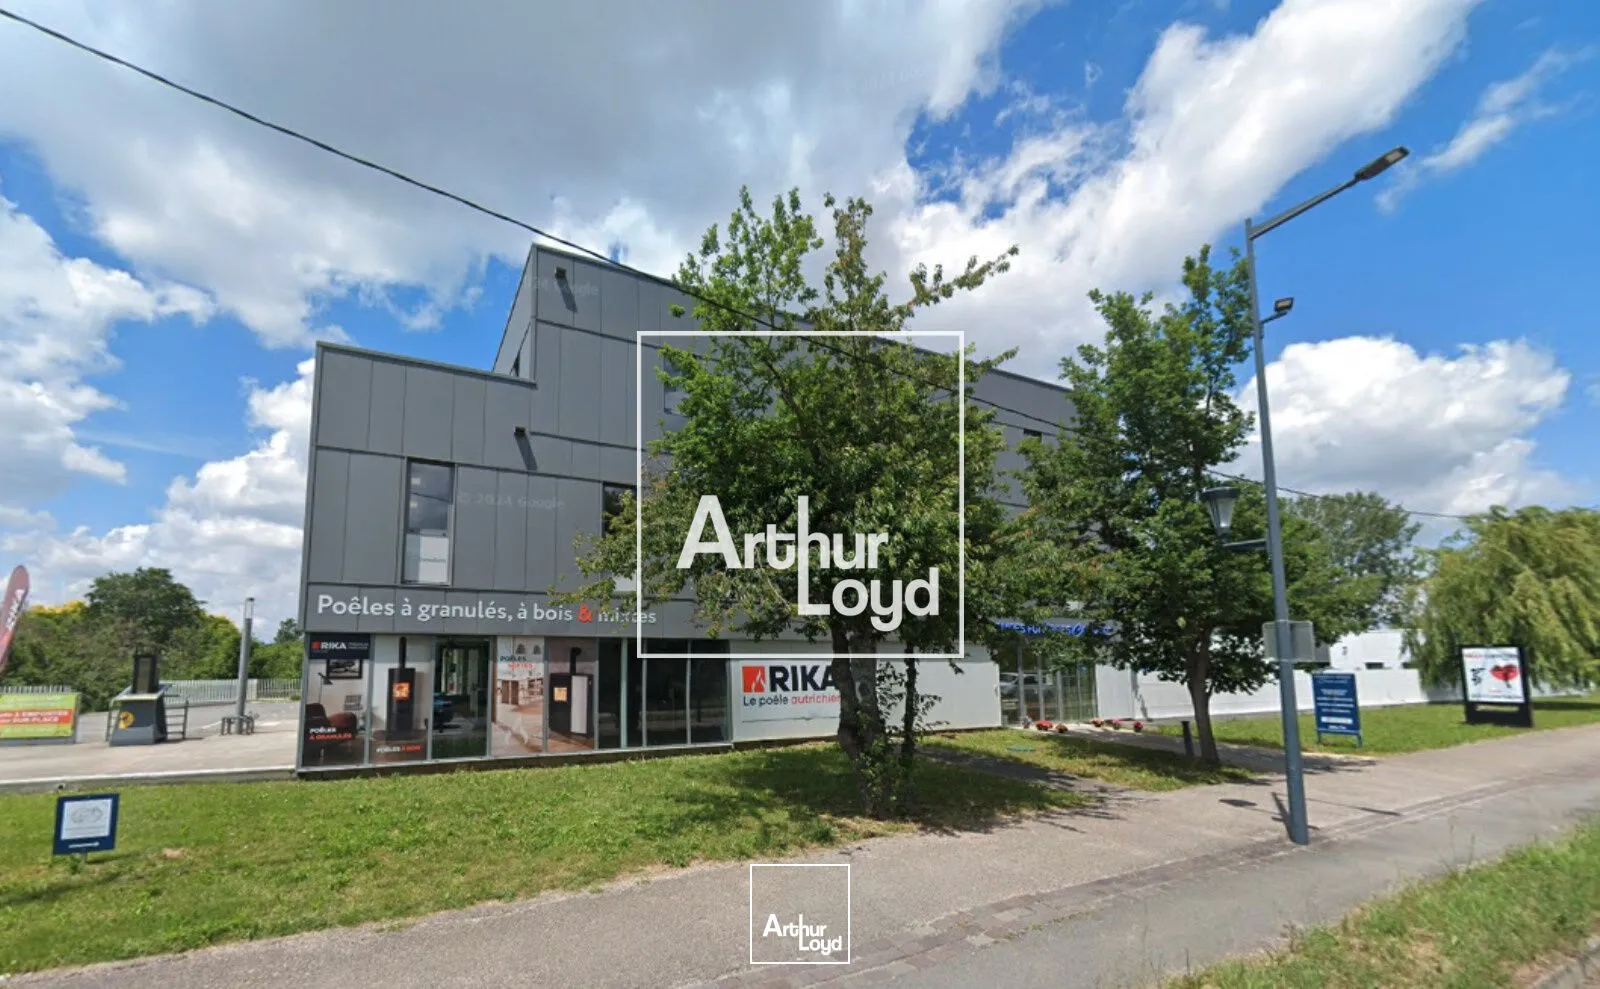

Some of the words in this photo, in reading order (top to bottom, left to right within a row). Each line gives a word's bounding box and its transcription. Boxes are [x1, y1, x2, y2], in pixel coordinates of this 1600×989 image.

[317, 594, 395, 616] Poêles
[402, 599, 412, 616] à
[417, 601, 513, 622] granulés,
[517, 603, 528, 619] à
[533, 604, 573, 621] bois
[577, 604, 593, 622] &
[320, 642, 347, 650] RIKA
[769, 665, 840, 692] RIKA
[743, 694, 757, 706] Le
[759, 694, 788, 707] poêle
